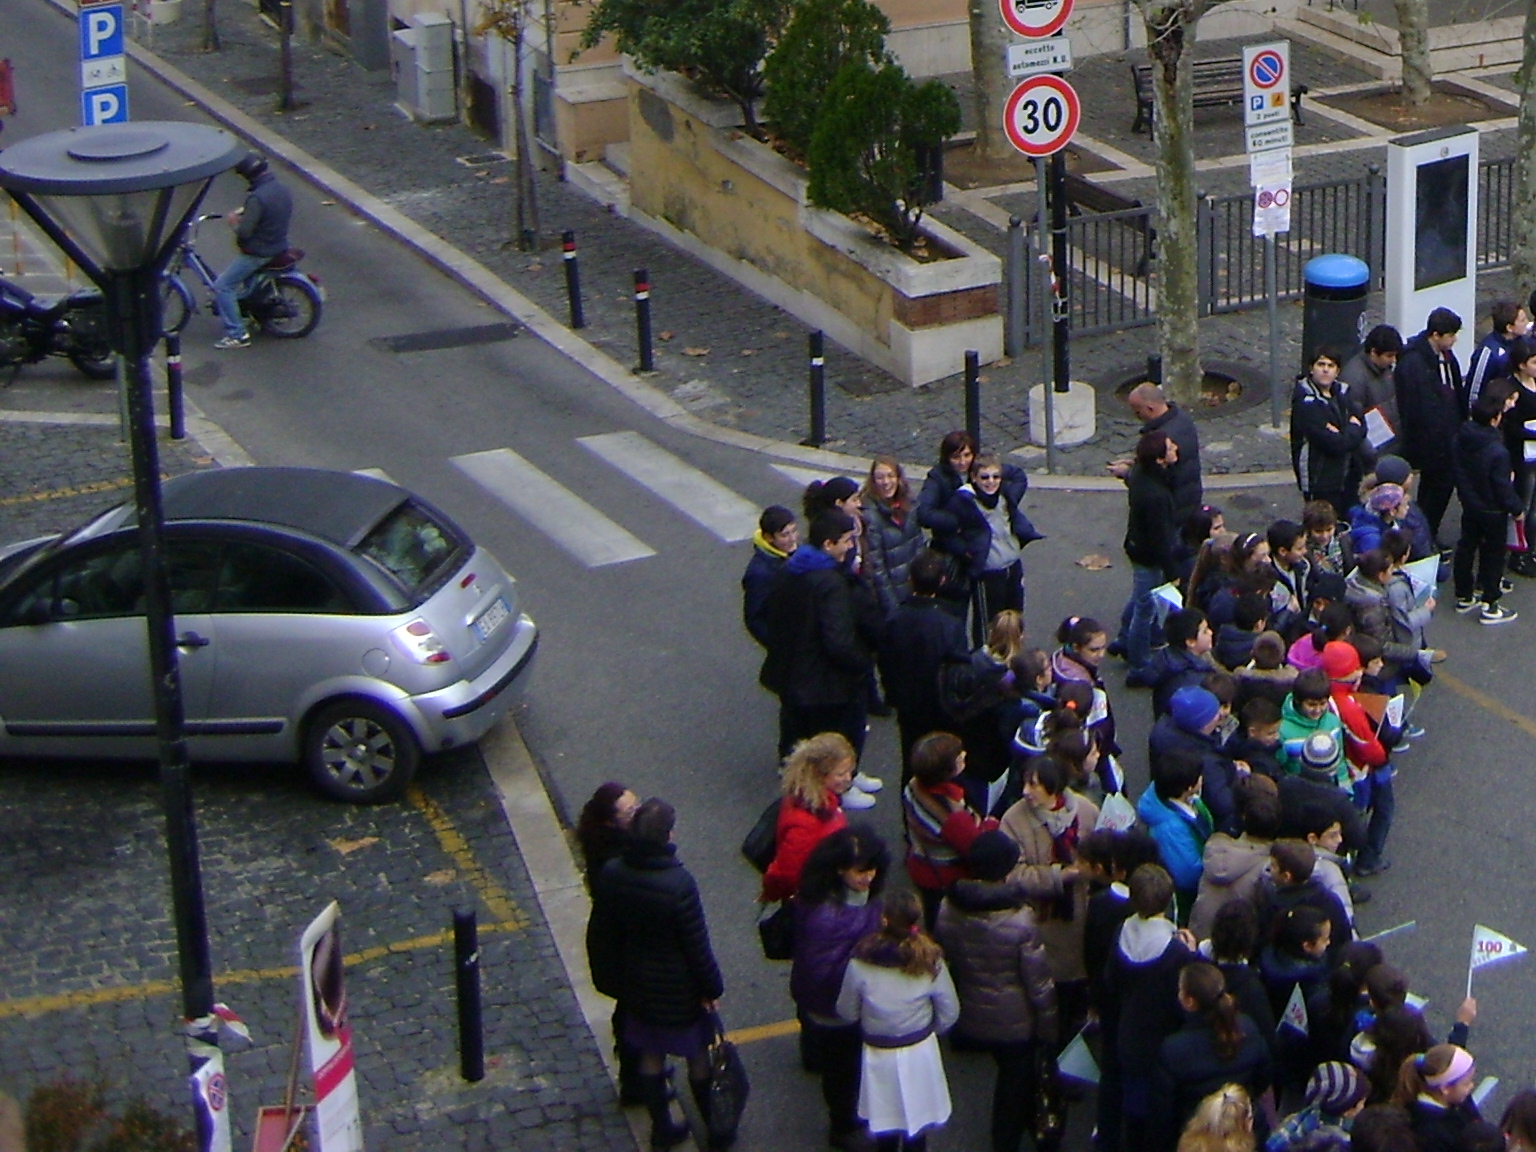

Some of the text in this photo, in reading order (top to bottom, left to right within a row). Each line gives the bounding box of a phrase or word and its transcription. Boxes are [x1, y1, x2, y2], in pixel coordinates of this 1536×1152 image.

[89, 12, 117, 55] P
[1024, 45, 1055, 55] eccetto
[1012, 59, 1050, 70] automezzi
[91, 93, 119, 126] P
[1252, 97, 1262, 110] P
[1022, 96, 1063, 135] 30
[1477, 940, 1502, 952] 100
